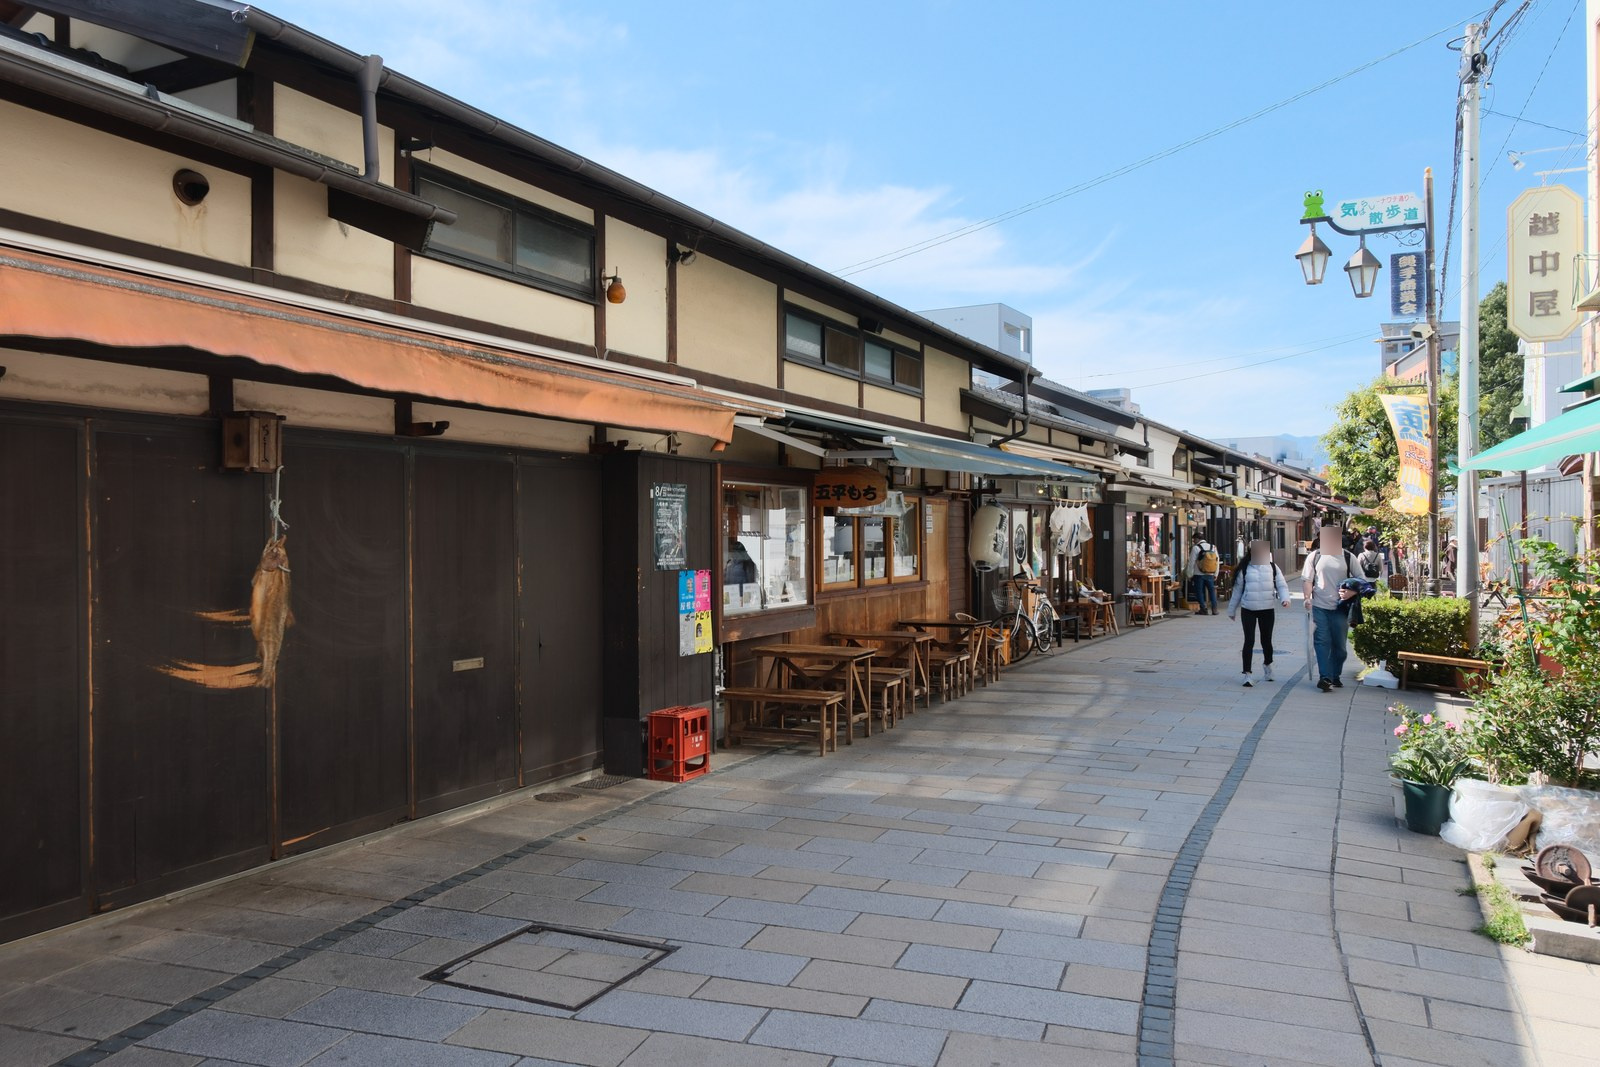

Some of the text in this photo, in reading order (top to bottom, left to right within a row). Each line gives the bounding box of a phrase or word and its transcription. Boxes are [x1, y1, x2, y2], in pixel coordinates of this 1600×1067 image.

[1529, 211, 1561, 318] 越中屋
[816, 484, 877, 501] 五平もち
